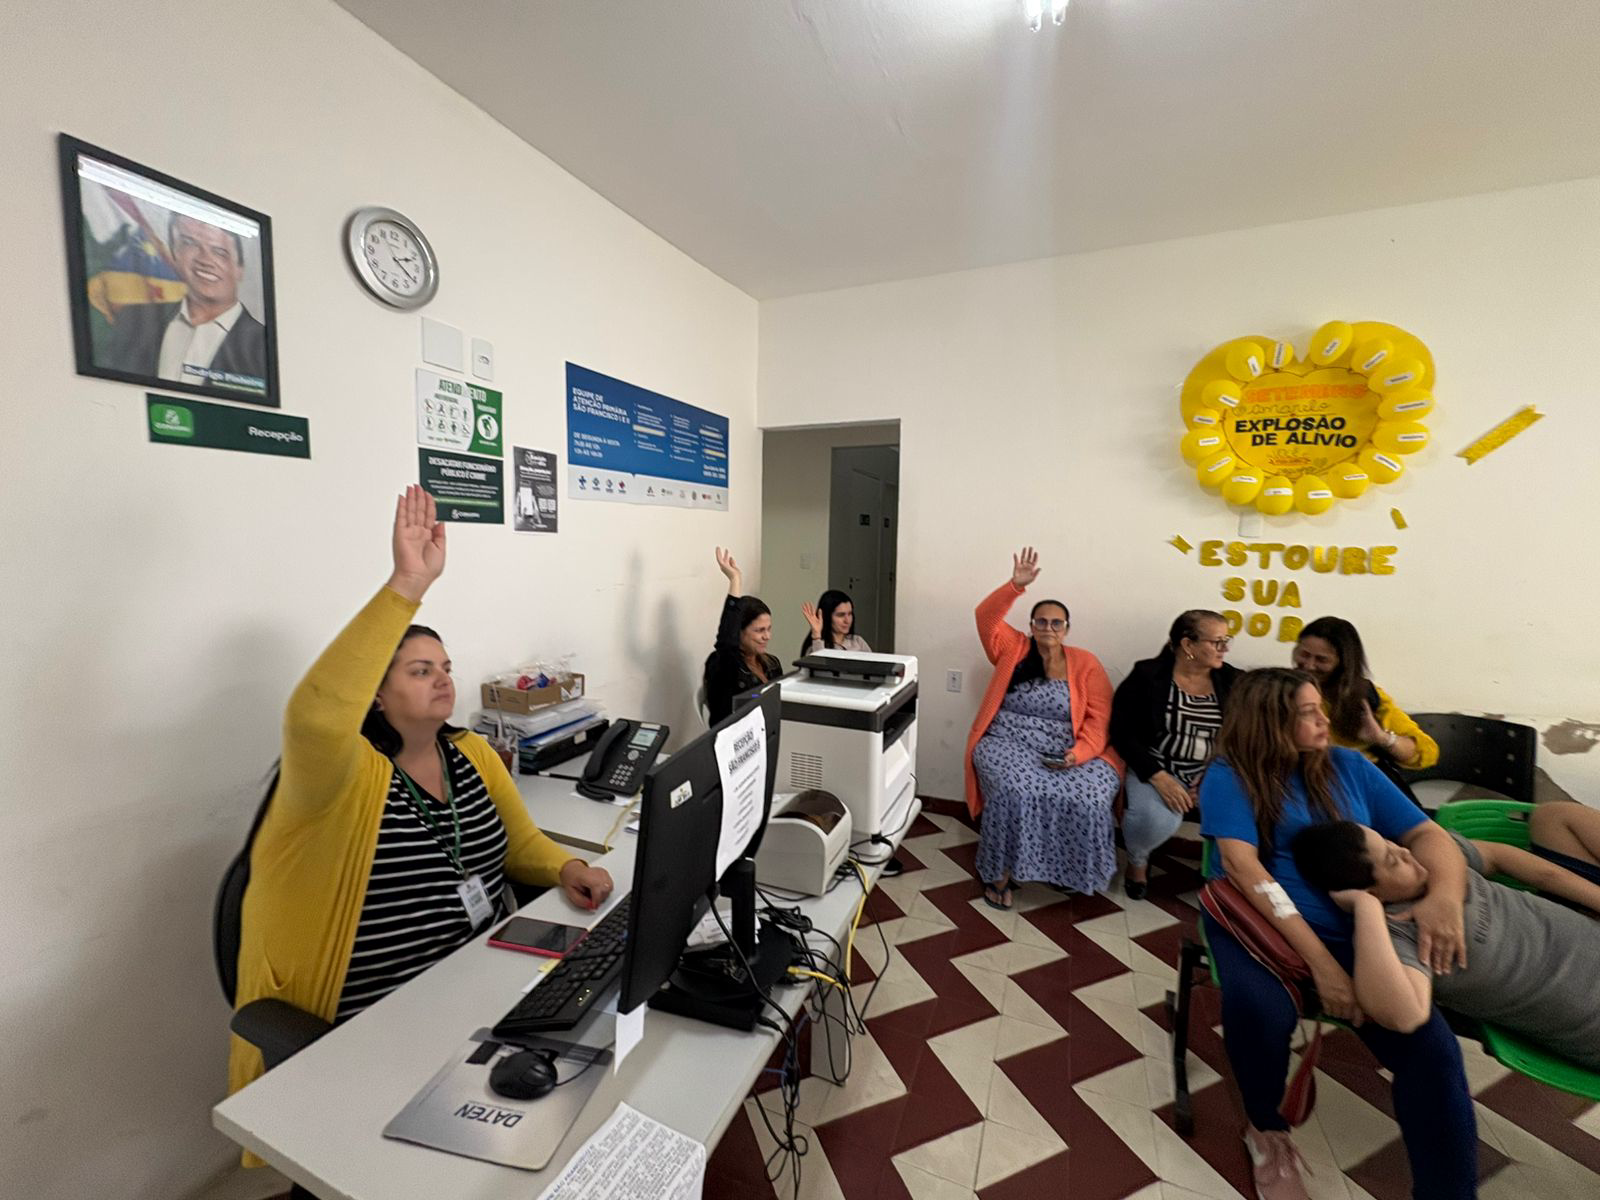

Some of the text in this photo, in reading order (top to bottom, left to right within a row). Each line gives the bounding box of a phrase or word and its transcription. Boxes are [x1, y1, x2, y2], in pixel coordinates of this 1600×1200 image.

[371, 235, 379, 244] 10
[390, 230, 399, 241] 12
[367, 245, 375, 255] 9
[371, 259, 379, 269] 8
[381, 270, 387, 280] 7
[392, 279, 399, 288] 6
[402, 279, 410, 289] 5
[573, 387, 603, 403] EQUIPE DE
[573, 395, 601, 410] ATENÇÃO
[573, 402, 587, 413] SÃO
[587, 407, 618, 422] FRANCISCO
[1234, 415, 1347, 433] EXPLOSÃO
[248, 425, 304, 443] Recepção
[1252, 432, 1278, 446] DE
[1200, 540, 1398, 575] ESTOURE
[1223, 577, 1302, 608] SUA
[453, 1103, 523, 1128] DATEN
